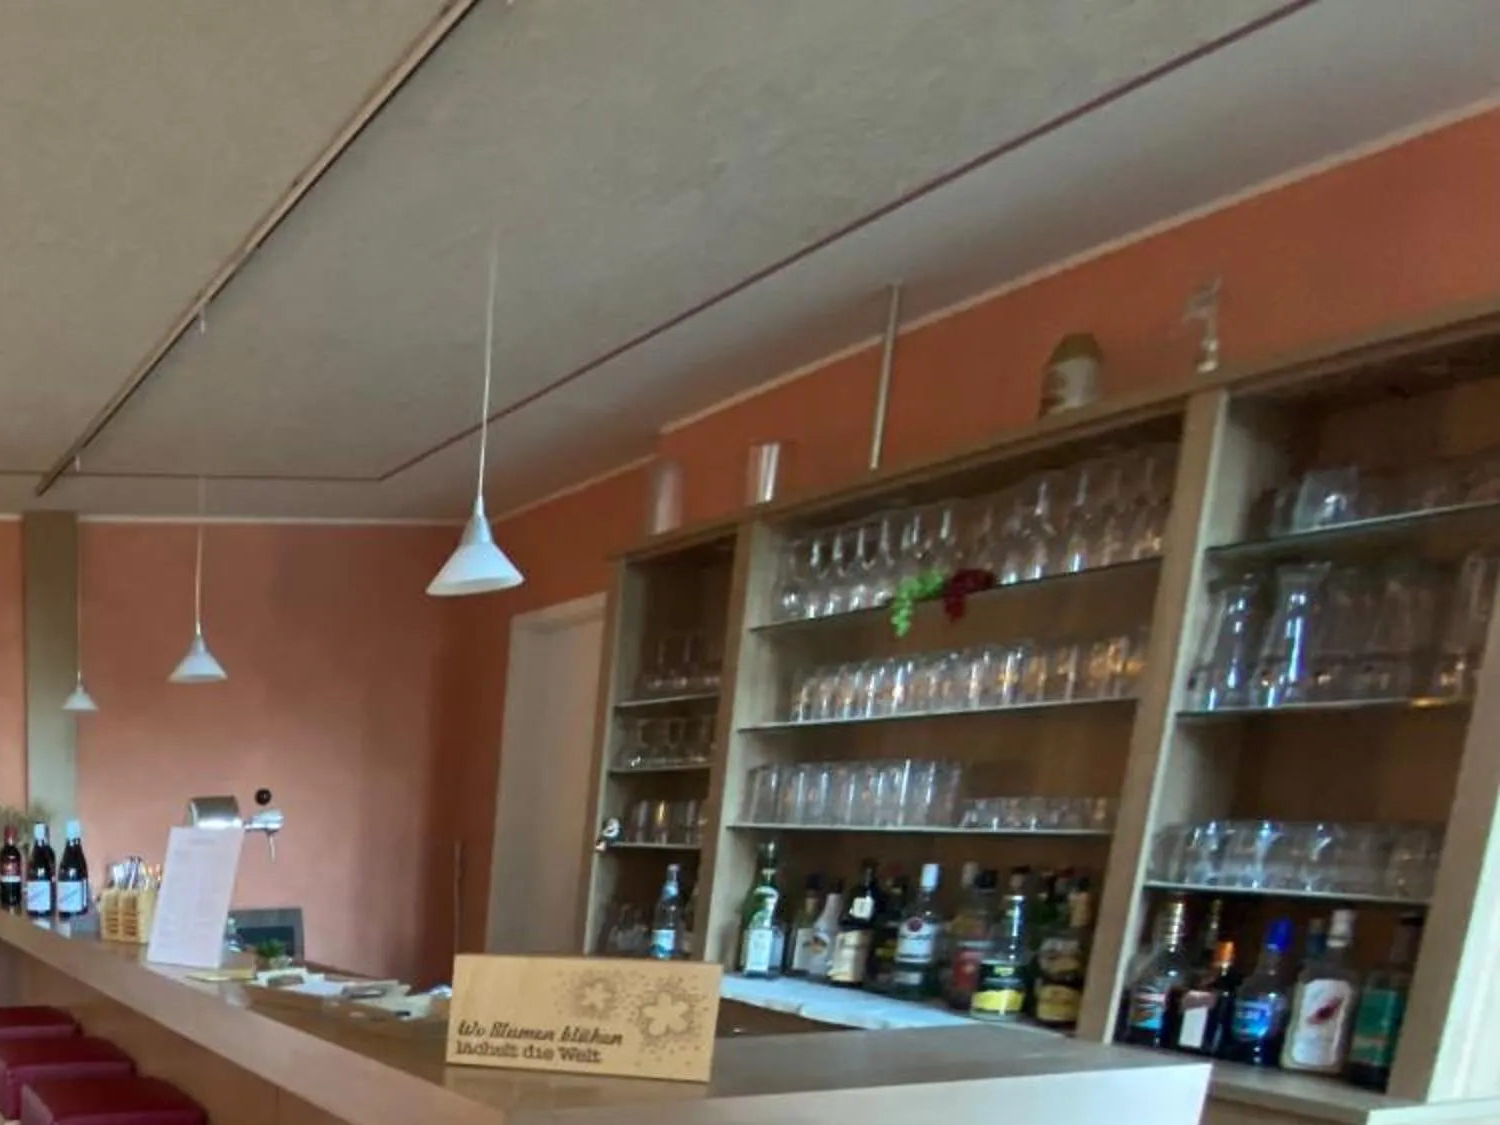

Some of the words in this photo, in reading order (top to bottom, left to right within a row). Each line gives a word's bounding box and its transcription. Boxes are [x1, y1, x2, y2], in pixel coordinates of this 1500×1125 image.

[458, 1020, 486, 1037] Wo
[490, 1021, 555, 1041] Blumen
[522, 1044, 554, 1061] die
